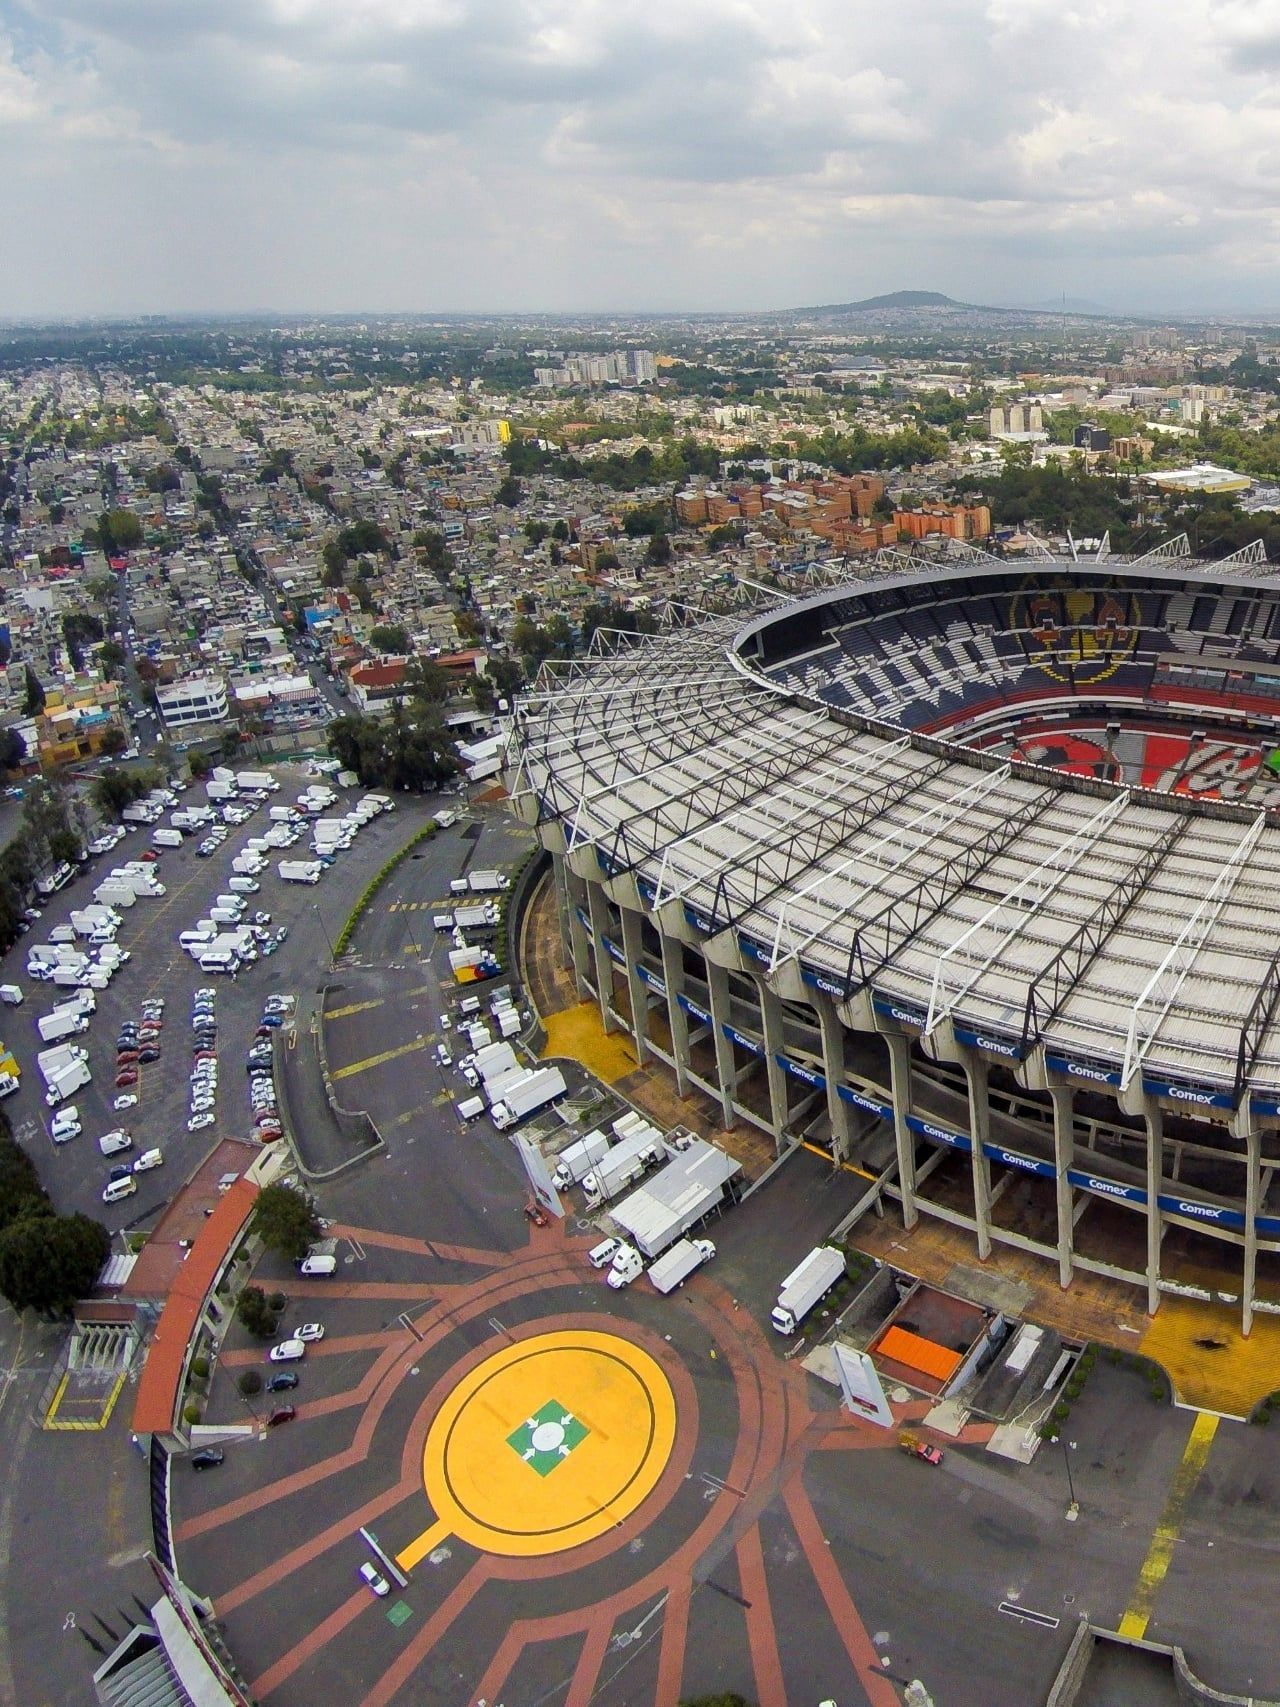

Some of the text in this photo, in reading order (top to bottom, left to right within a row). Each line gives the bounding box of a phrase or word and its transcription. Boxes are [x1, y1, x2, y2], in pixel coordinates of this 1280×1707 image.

[756, 950, 772, 964] Com
[687, 1002, 707, 1020] Comex
[733, 1031, 758, 1052] Comex
[976, 1037, 1015, 1056] Comex
[789, 1063, 816, 1082] Comex
[1068, 1063, 1111, 1082] Comex
[852, 1093, 882, 1113] Comex
[1169, 1087, 1216, 1105] Comex
[923, 1123, 957, 1143] Comex
[1002, 1152, 1040, 1170] Comex
[1089, 1179, 1130, 1197] Comex
[1179, 1203, 1222, 1218] Comex
